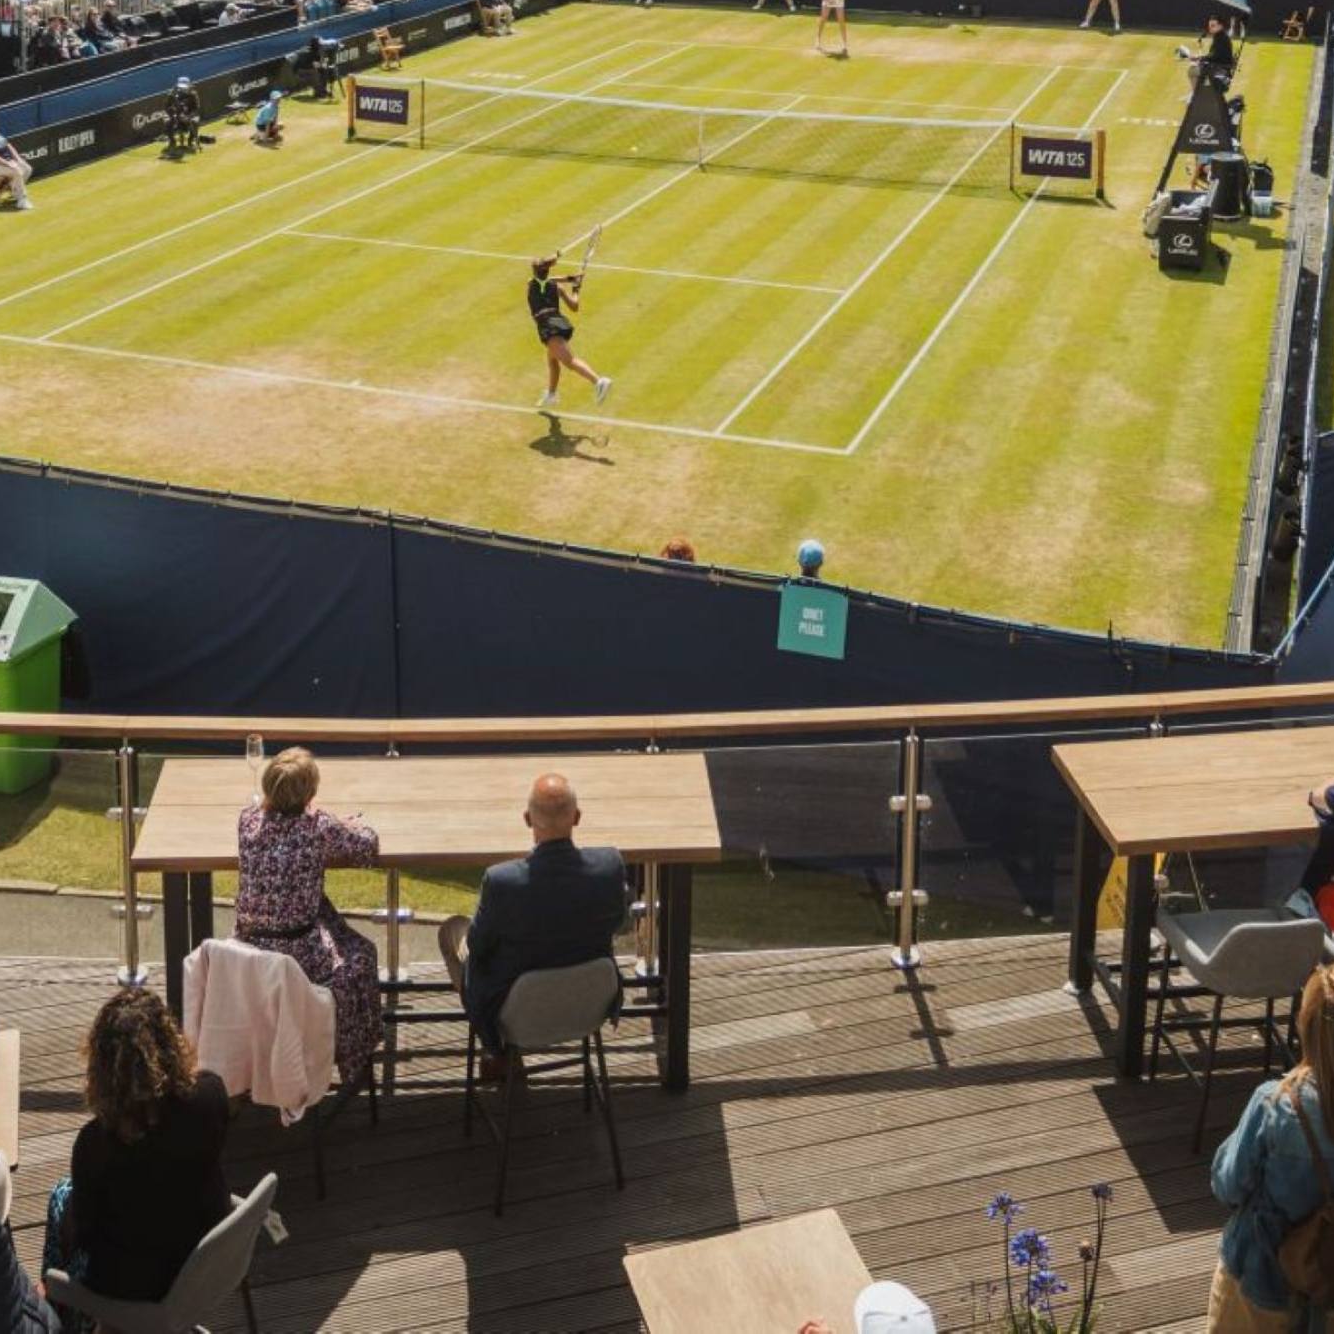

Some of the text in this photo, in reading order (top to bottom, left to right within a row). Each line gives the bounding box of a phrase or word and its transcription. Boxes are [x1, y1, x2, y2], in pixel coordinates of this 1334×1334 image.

[359, 96, 403, 114] WTA 125
[1028, 148, 1085, 167] WTA 125
